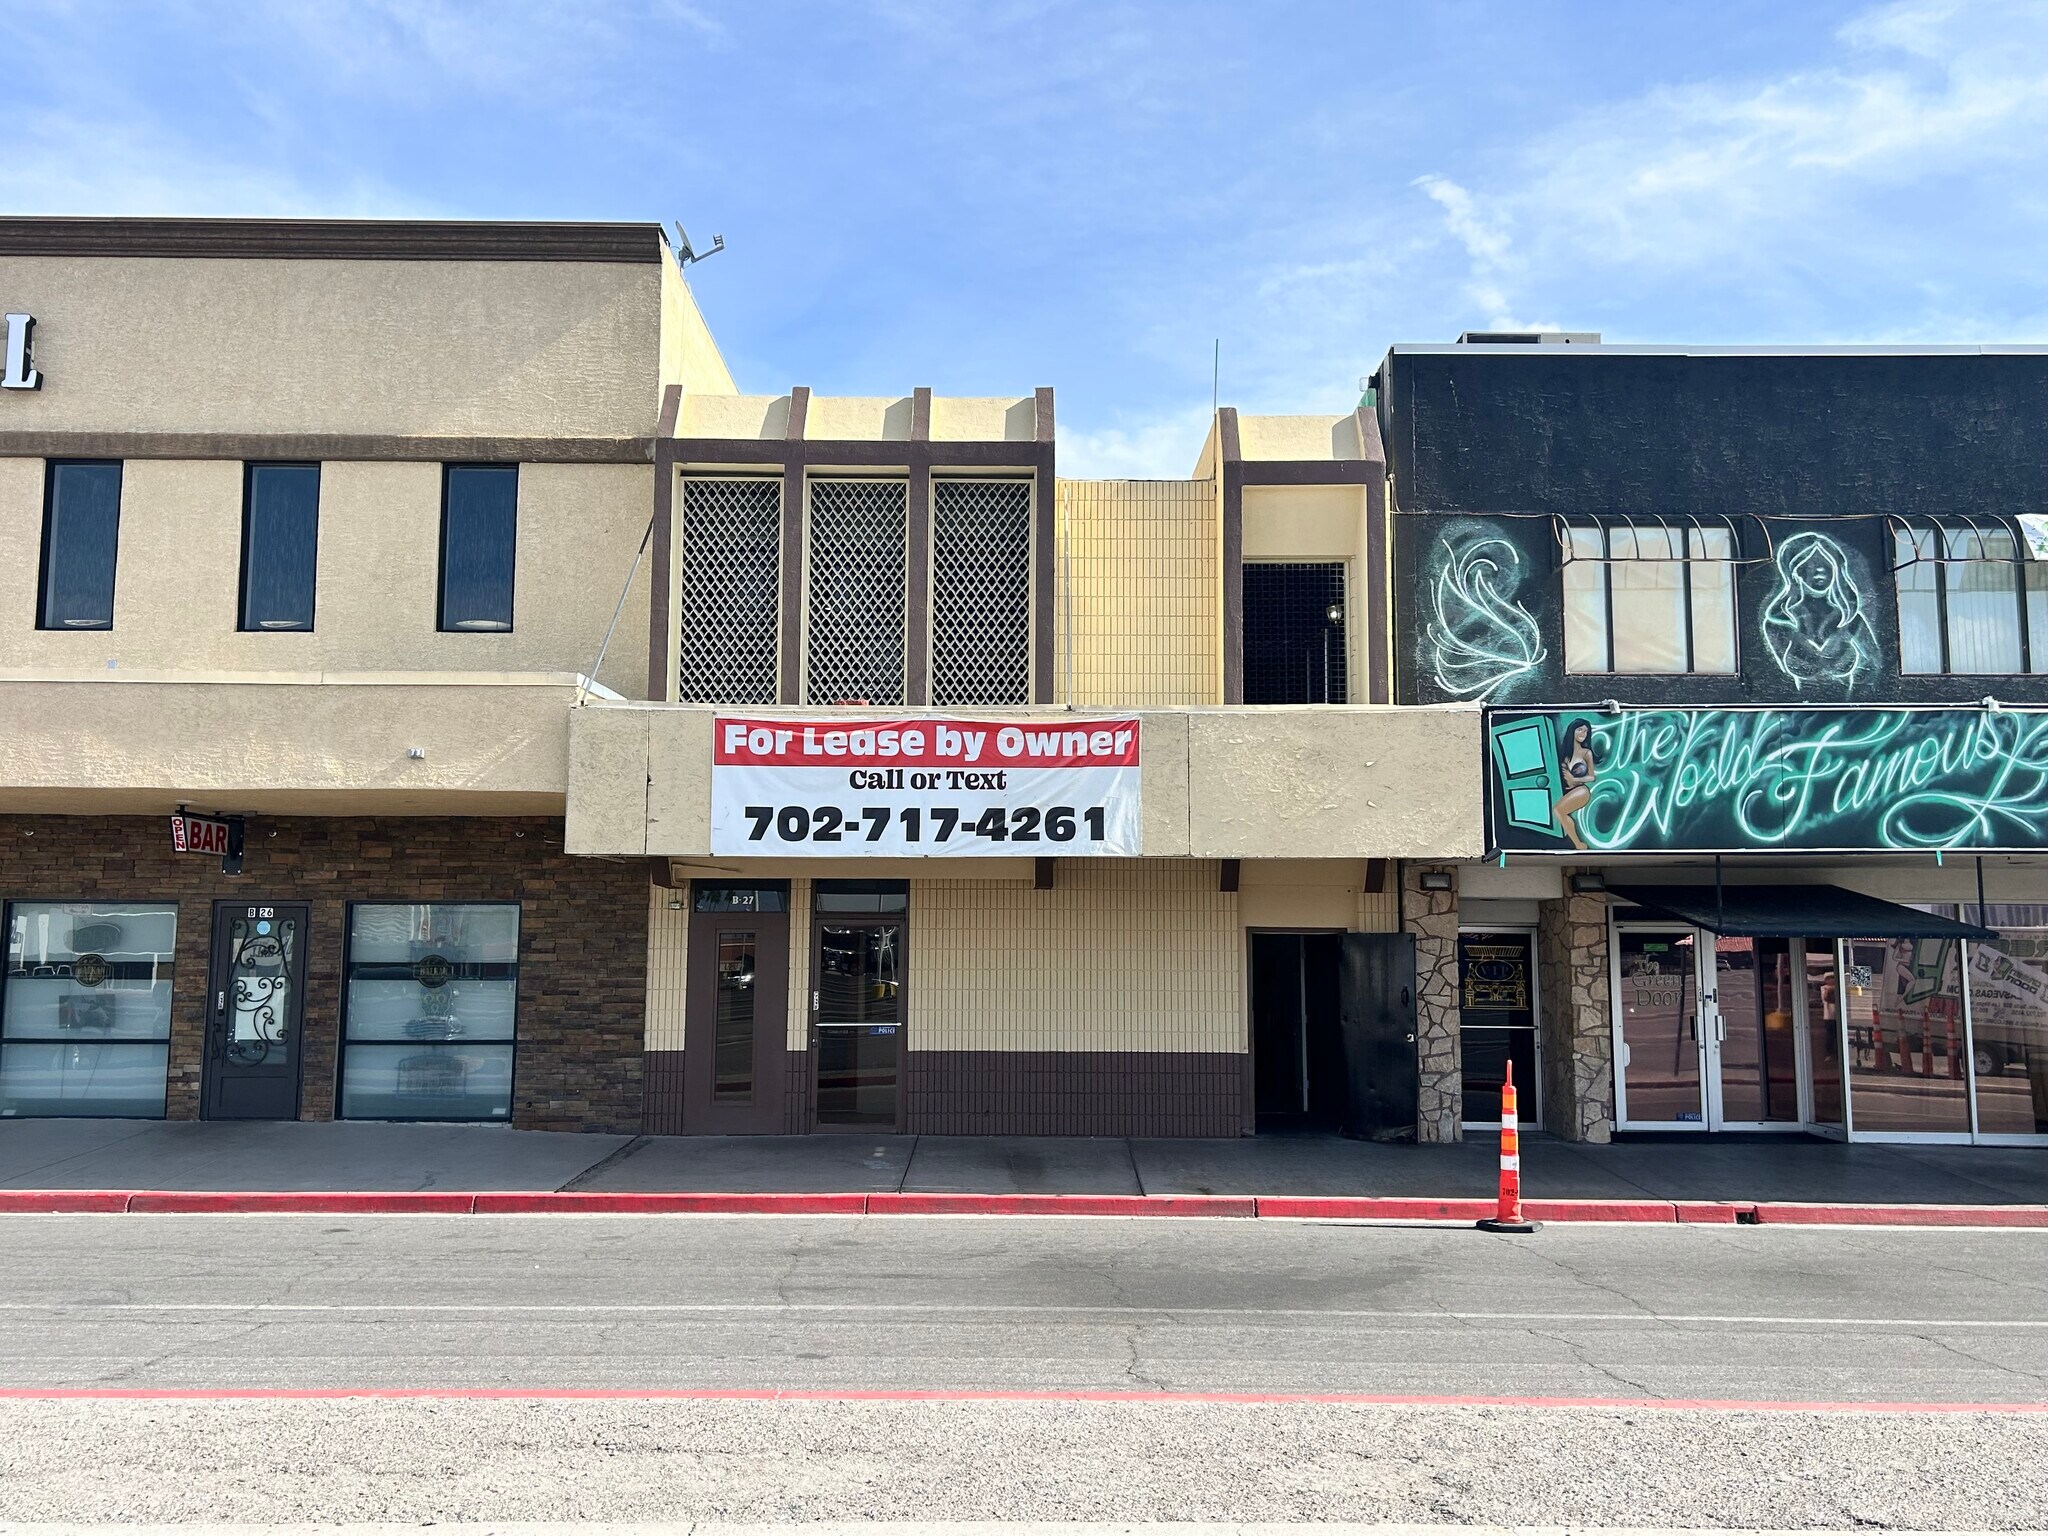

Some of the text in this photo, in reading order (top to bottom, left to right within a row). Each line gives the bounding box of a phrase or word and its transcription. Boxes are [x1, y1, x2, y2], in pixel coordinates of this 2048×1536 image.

[1, 313, 39, 388] L
[724, 724, 1132, 762] For Lease by Owner
[1590, 711, 1690, 774] The
[849, 768, 1007, 790] Call or Text
[1577, 711, 1783, 849] World
[1737, 711, 2003, 842] Famous
[173, 818, 186, 849] OPEN
[189, 820, 228, 854] BAR
[744, 806, 1105, 842] 702-717-4261
[249, 908, 273, 917] B 26
[1636, 990, 1684, 1006] Door
